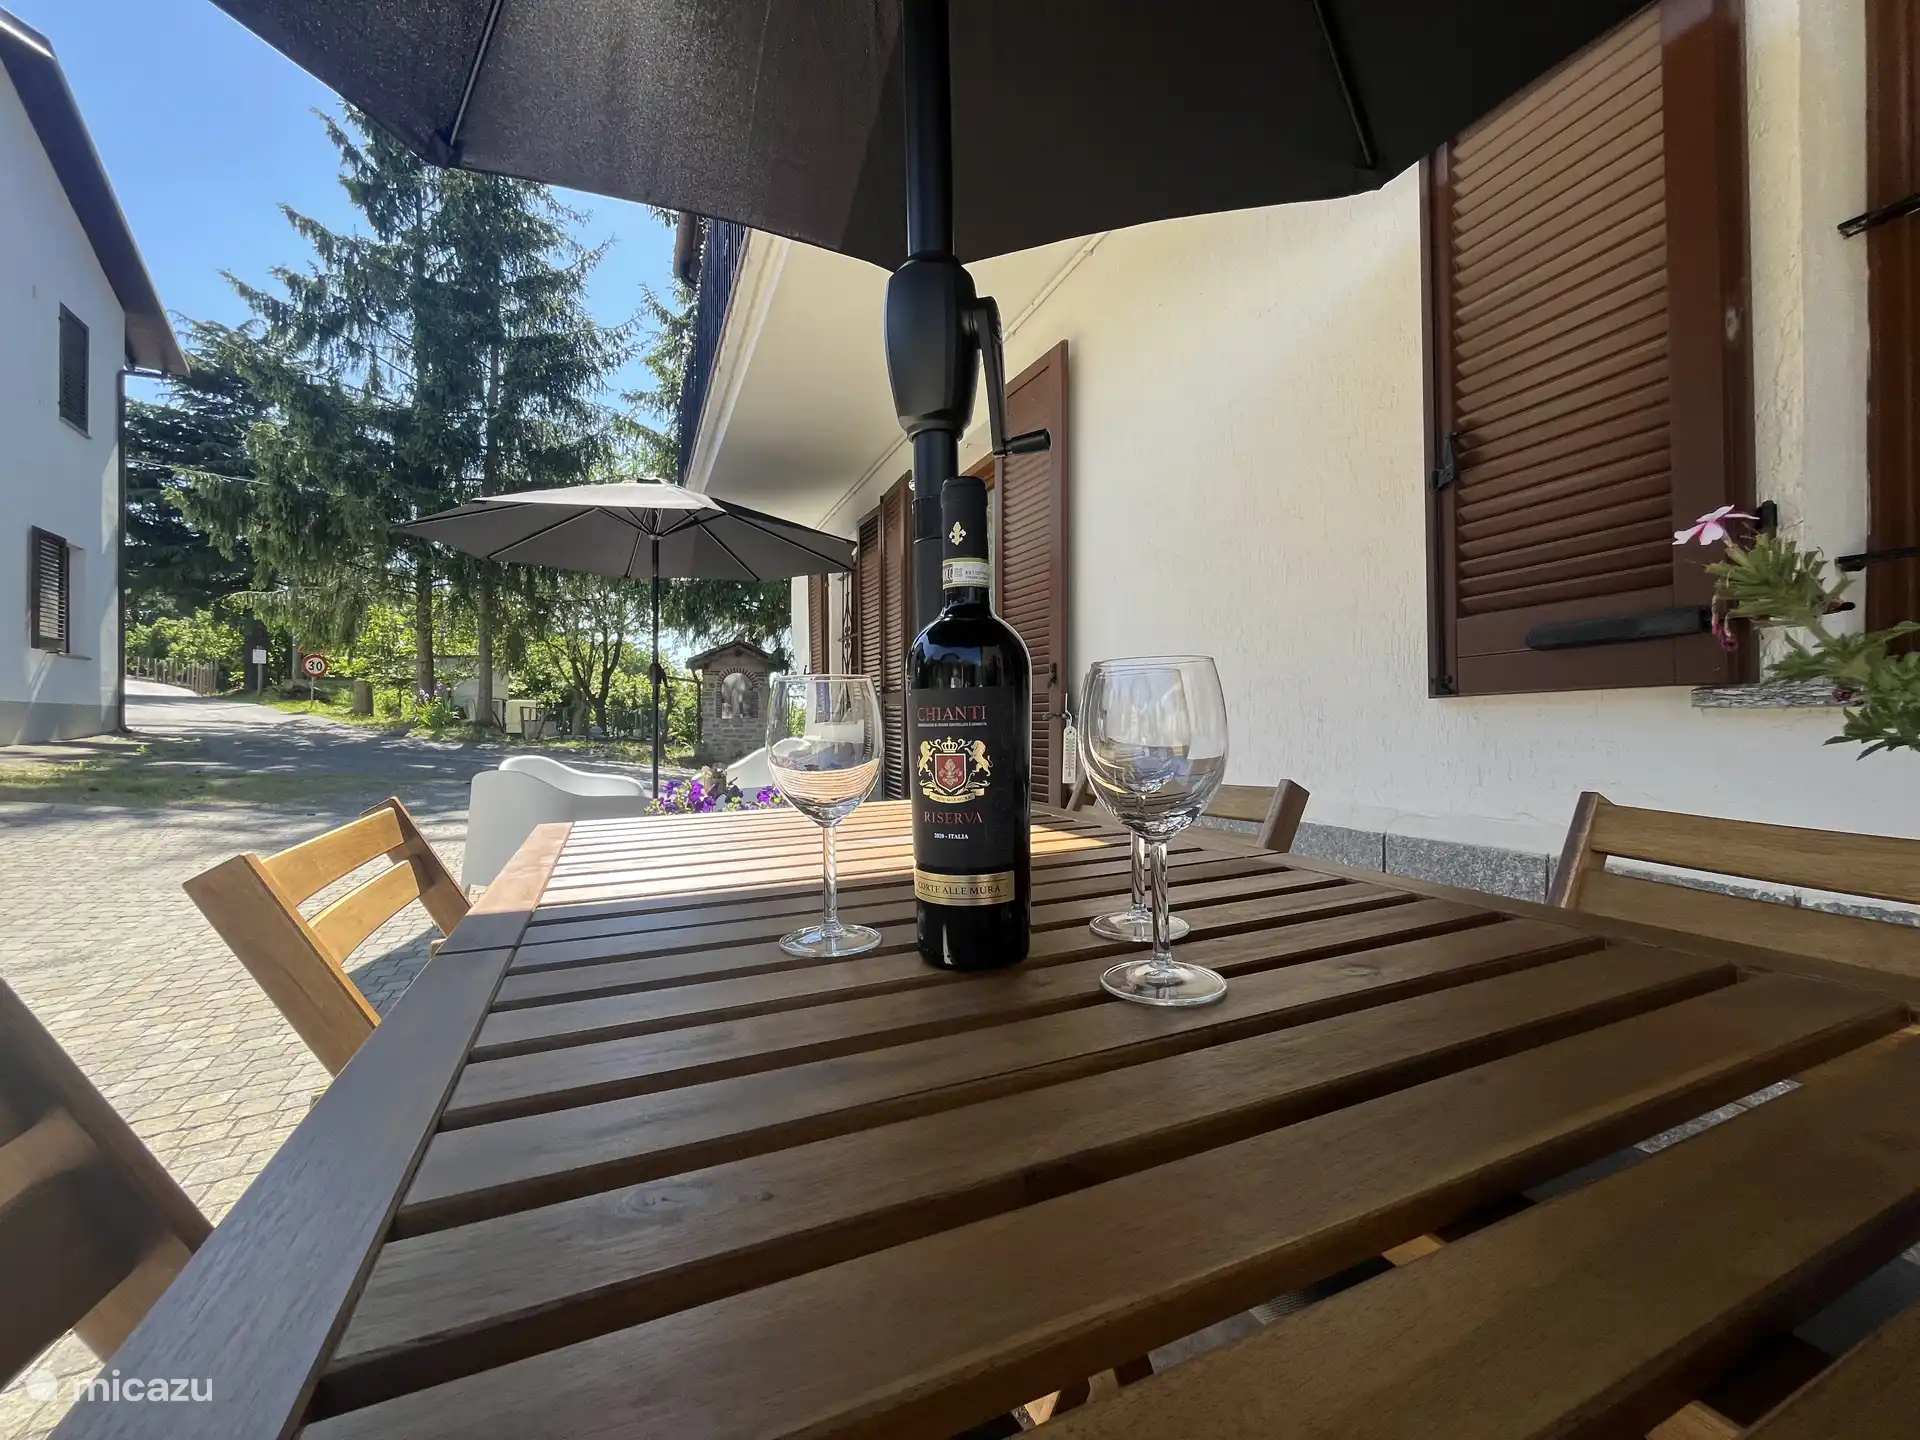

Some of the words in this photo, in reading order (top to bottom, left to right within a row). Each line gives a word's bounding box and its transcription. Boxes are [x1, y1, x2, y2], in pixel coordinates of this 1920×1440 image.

[308, 660, 323, 671] 30
[917, 705, 986, 721] CHIANTI
[924, 810, 983, 825] RISERVA
[918, 881, 940, 893] CORTE
[942, 886, 967, 895] ALLE
[969, 885, 1001, 895] MURA
